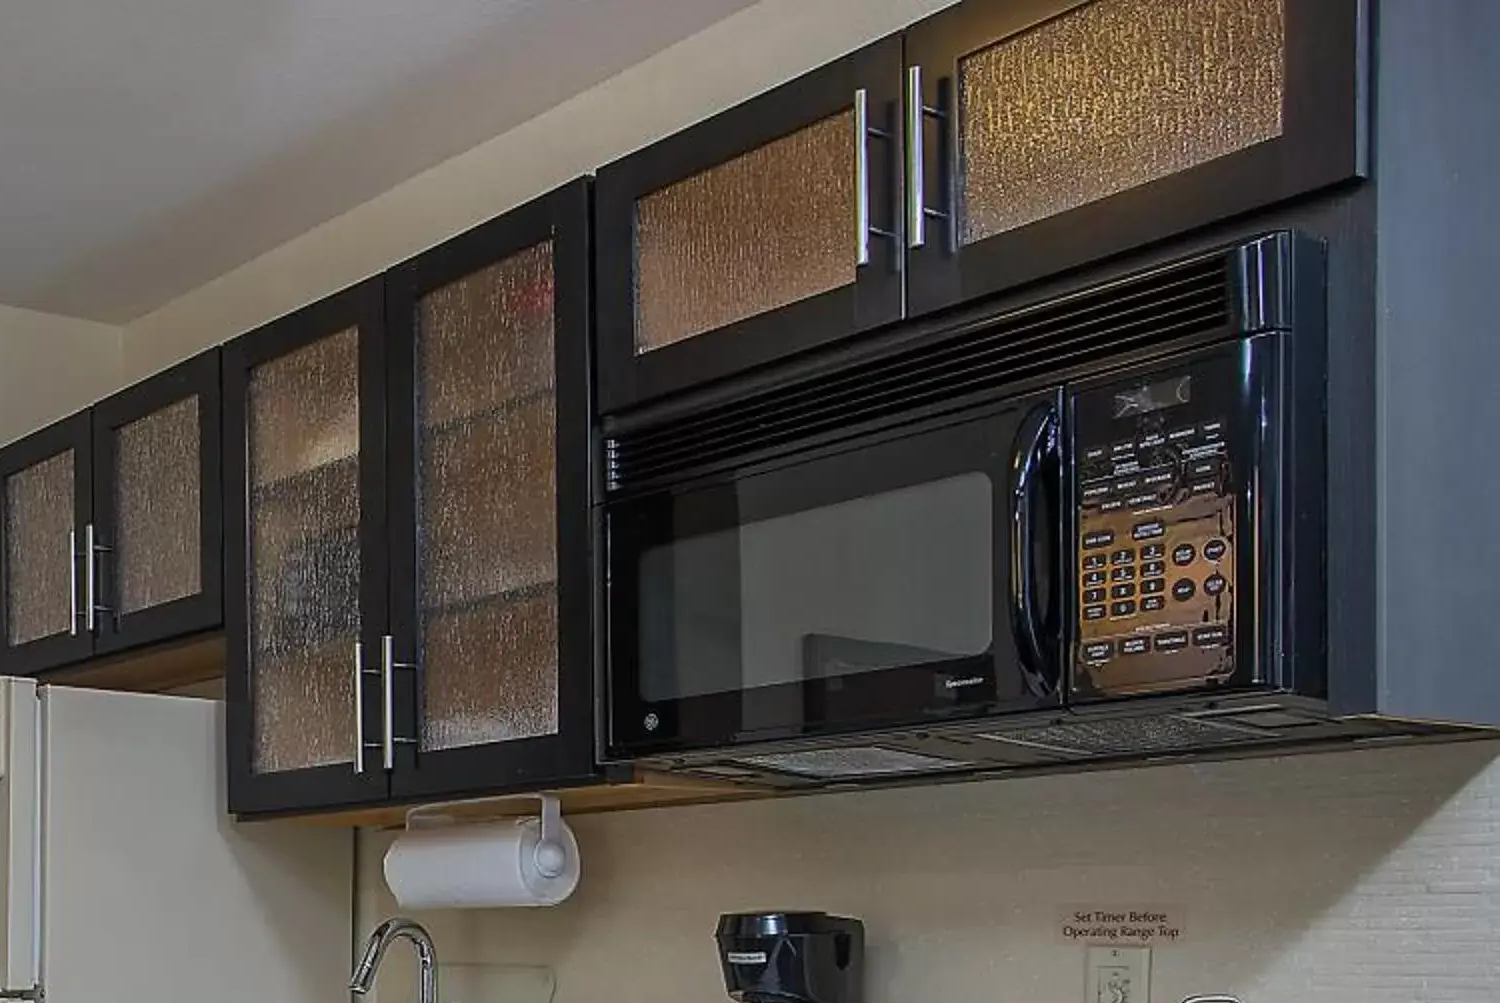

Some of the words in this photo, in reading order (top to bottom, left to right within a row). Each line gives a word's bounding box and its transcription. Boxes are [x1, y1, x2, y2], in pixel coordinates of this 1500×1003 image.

[1074, 911, 1092, 923] Set
[1094, 911, 1126, 923] Timer
[1129, 911, 1167, 923] Before
[1062, 925, 1117, 939] Operating
[1120, 925, 1155, 940] Range
[1157, 925, 1181, 940] Top
